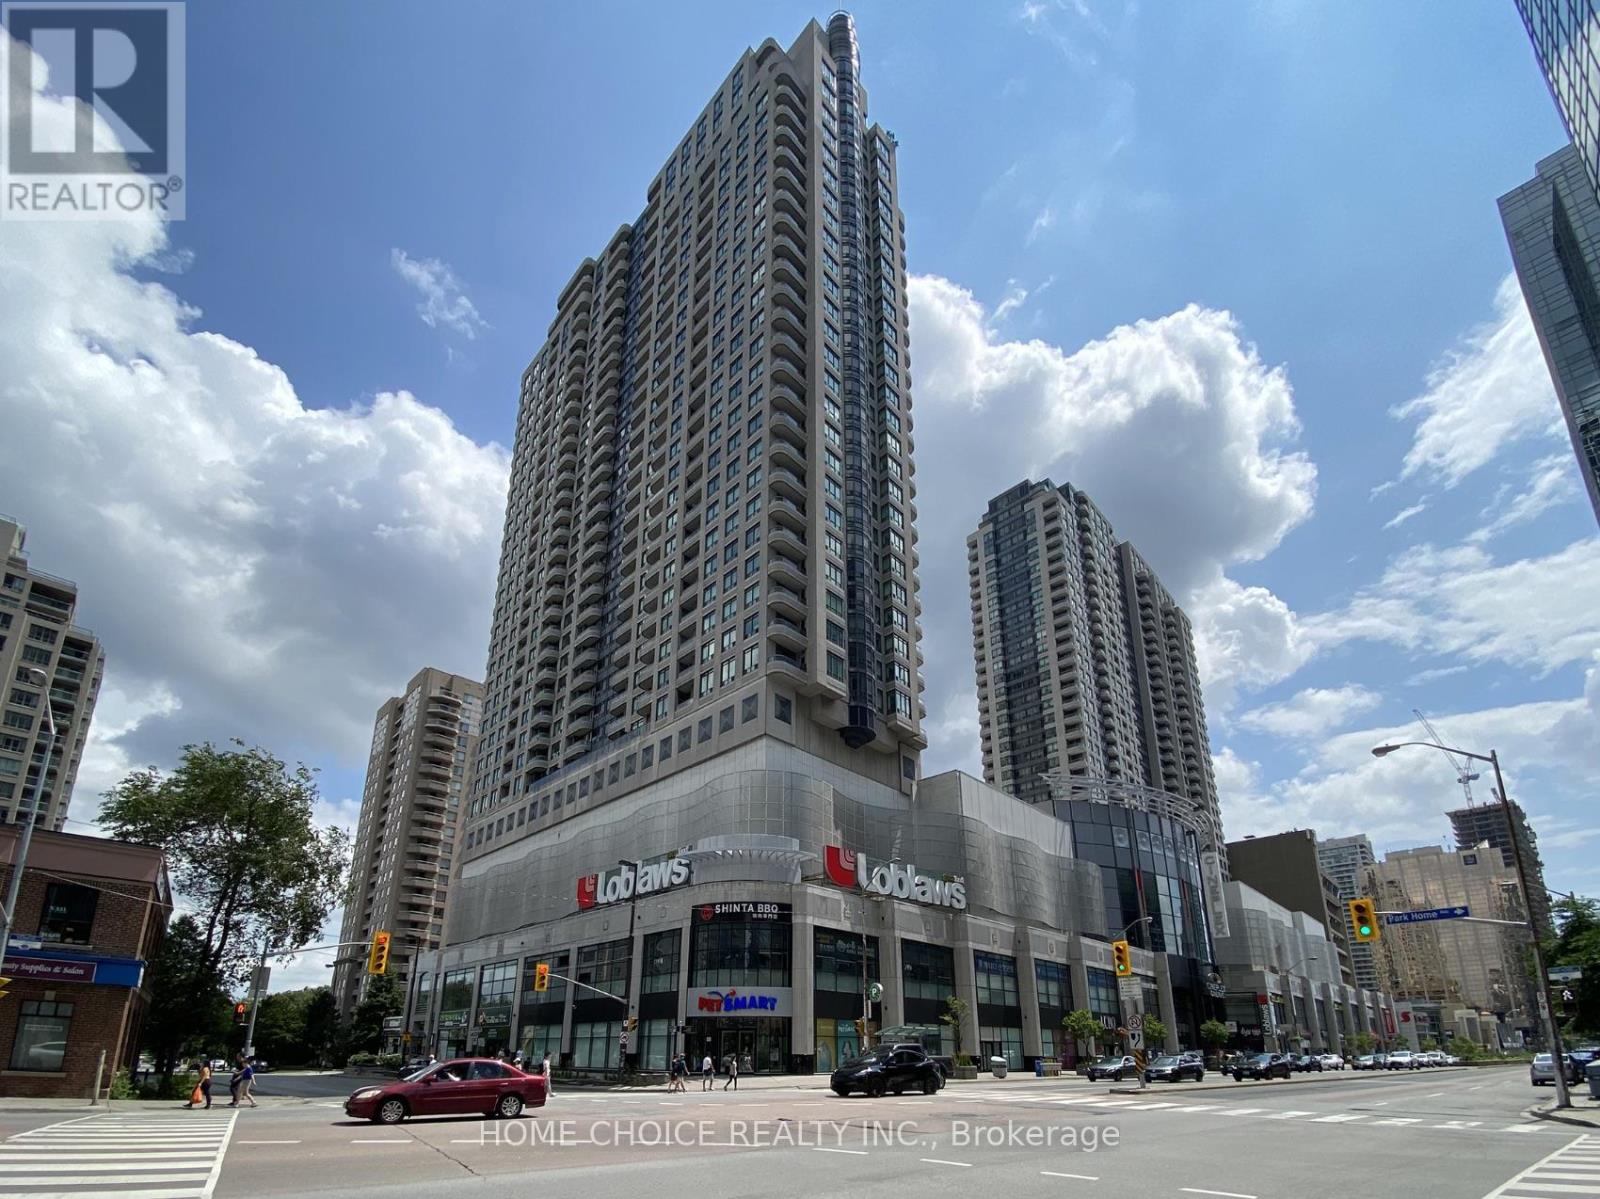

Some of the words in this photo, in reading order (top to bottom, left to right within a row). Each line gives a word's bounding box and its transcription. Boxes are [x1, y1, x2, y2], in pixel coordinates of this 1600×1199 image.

[597, 857, 690, 904] Loblaws
[857, 853, 967, 910] Loblaws
[714, 903, 754, 913] SHINTA
[757, 903, 779, 913] BBQ
[1388, 913, 1408, 922] Park
[1411, 911, 1438, 920] Home
[20, 963, 52, 974] Supplies
[52, 965, 62, 973] &
[62, 966, 84, 975] Salon
[697, 992, 778, 1012] PETSMART
[1261, 1004, 1272, 1035] Loblaws
